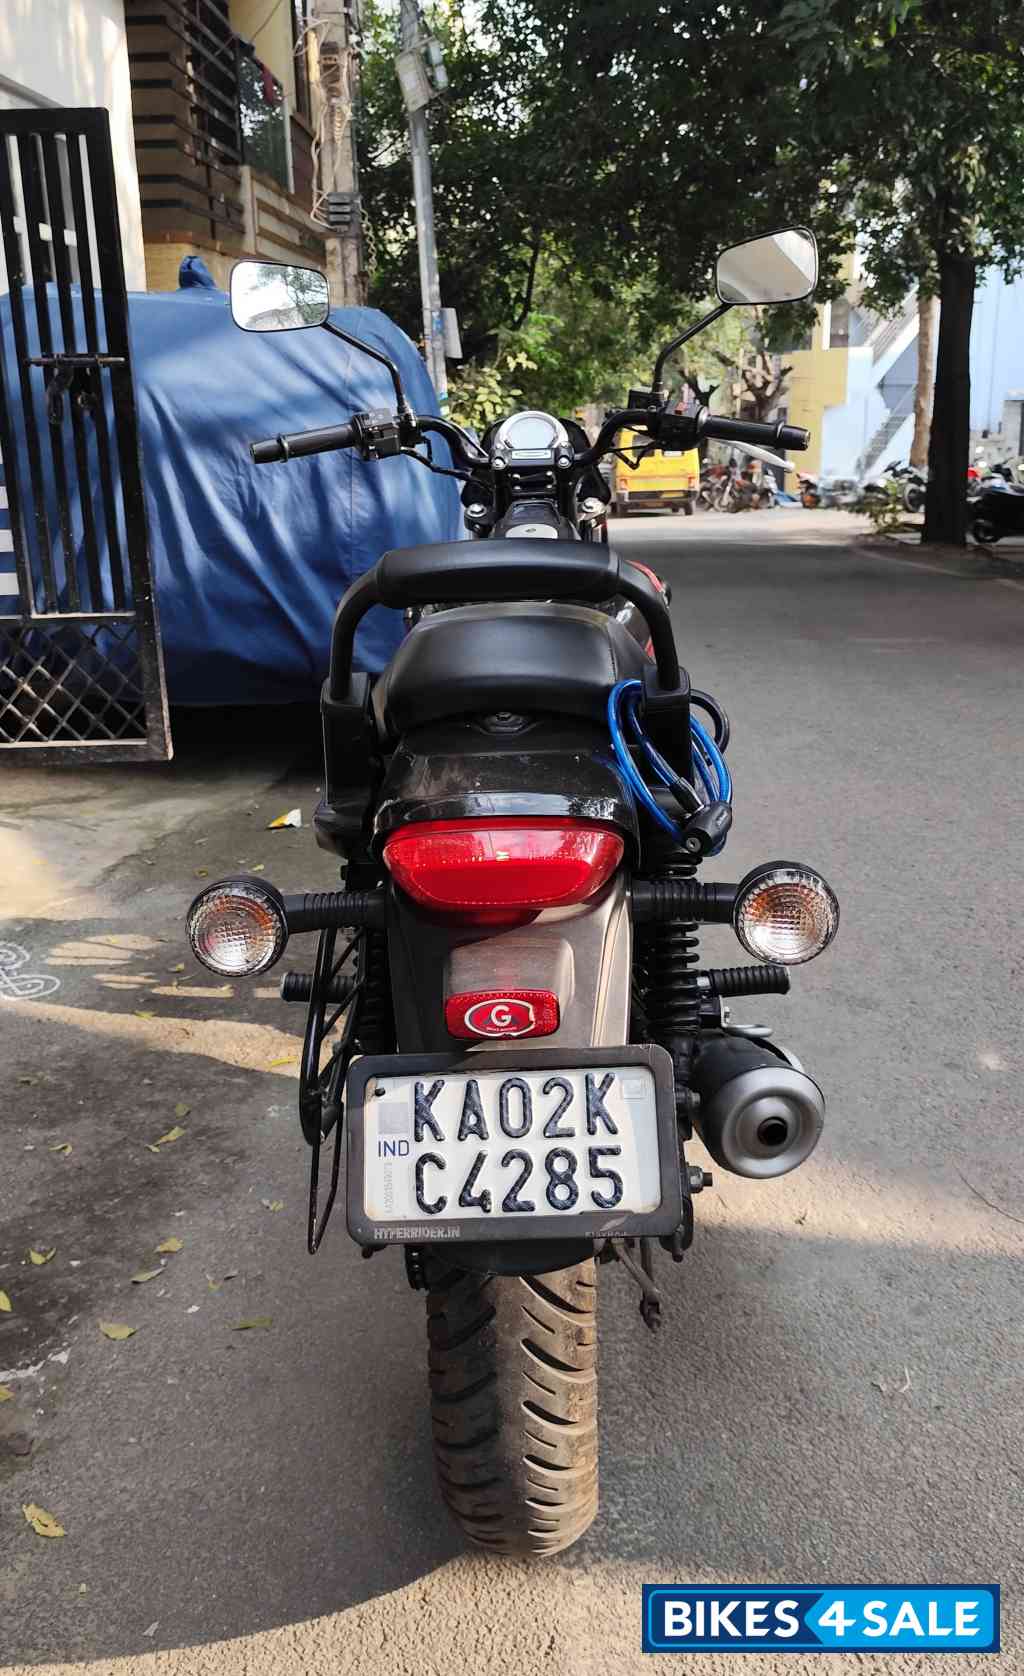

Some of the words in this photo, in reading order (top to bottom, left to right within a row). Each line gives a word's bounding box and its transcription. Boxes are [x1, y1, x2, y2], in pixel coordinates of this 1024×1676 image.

[413, 1072, 619, 1142] KA02K
[378, 1140, 410, 1157] IND
[415, 1145, 624, 1215] C4285
